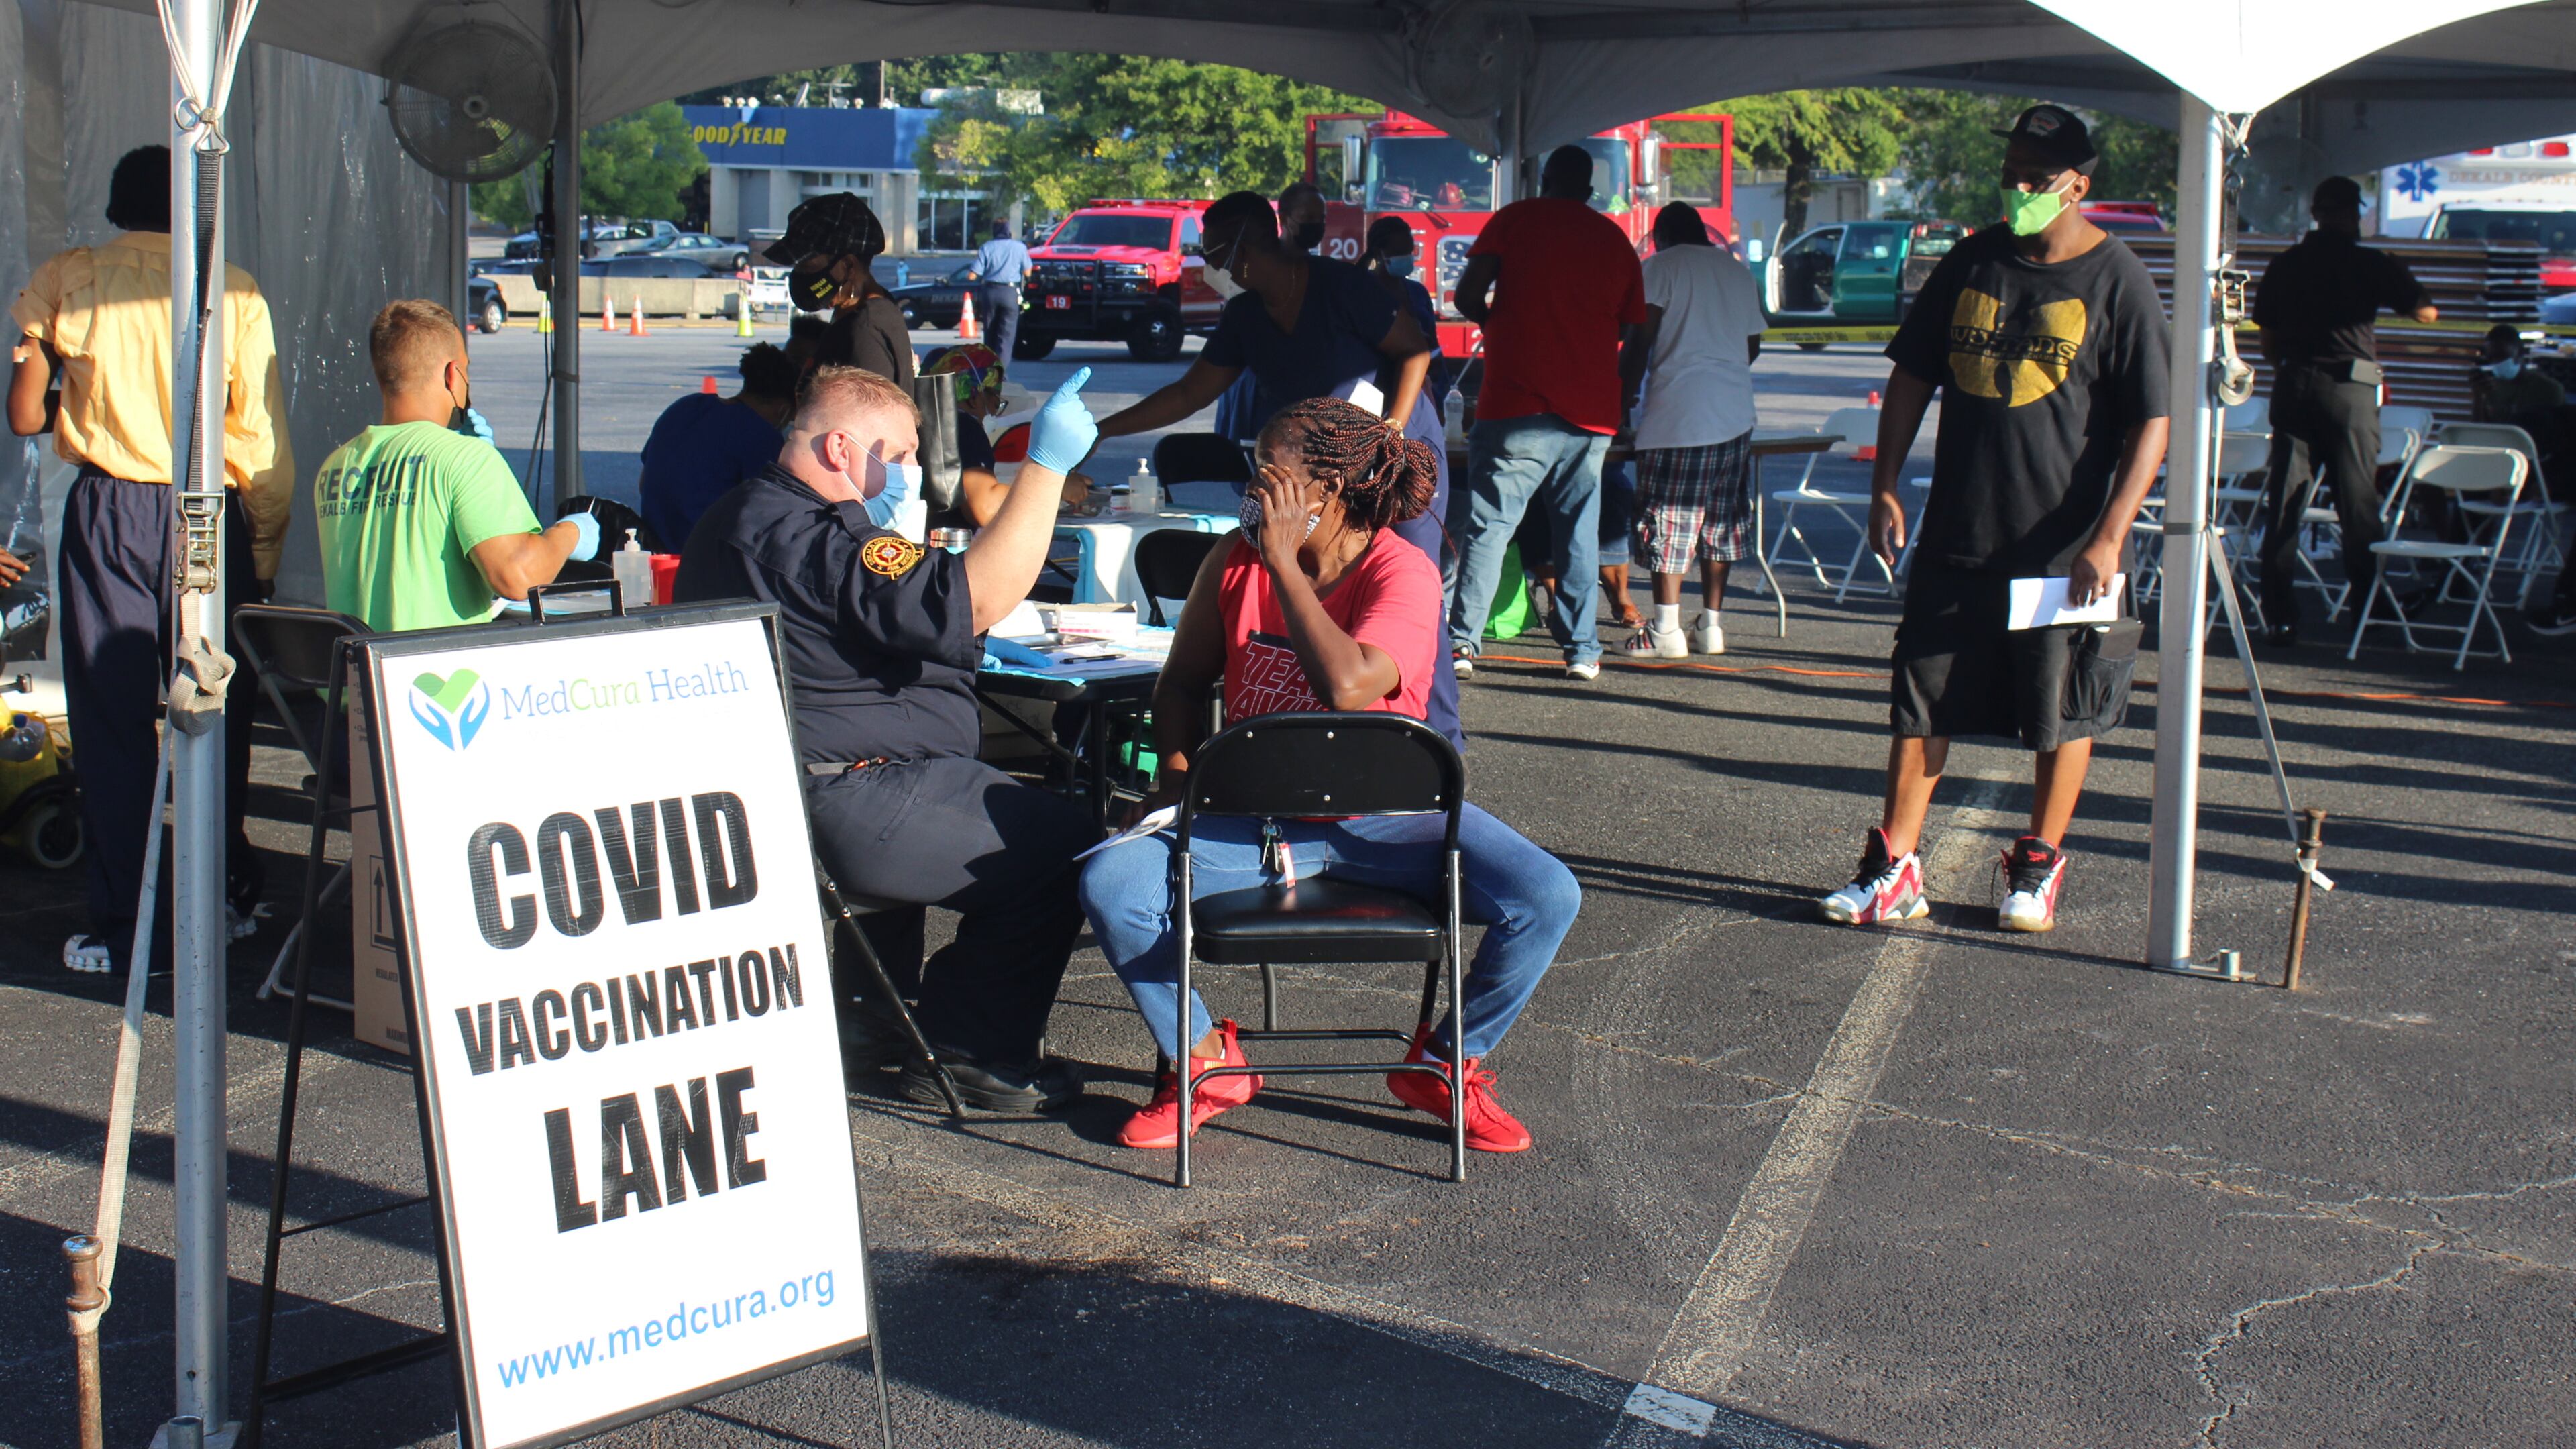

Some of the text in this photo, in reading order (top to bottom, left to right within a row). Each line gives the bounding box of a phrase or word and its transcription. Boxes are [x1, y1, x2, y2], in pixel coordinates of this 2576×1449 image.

[691, 123, 787, 146] OODYEAR
[1329, 237, 1358, 260] 20
[1051, 296, 1066, 309] 19
[320, 502, 346, 519] EKALB
[501, 661, 749, 721] MedCura Health
[1242, 641, 1317, 700] TEA
[468, 791, 758, 950] COVID
[455, 943, 803, 1075] VACCINATION
[544, 1066, 767, 1234] LANE
[498, 1268, 836, 1389] www.medcura.org
